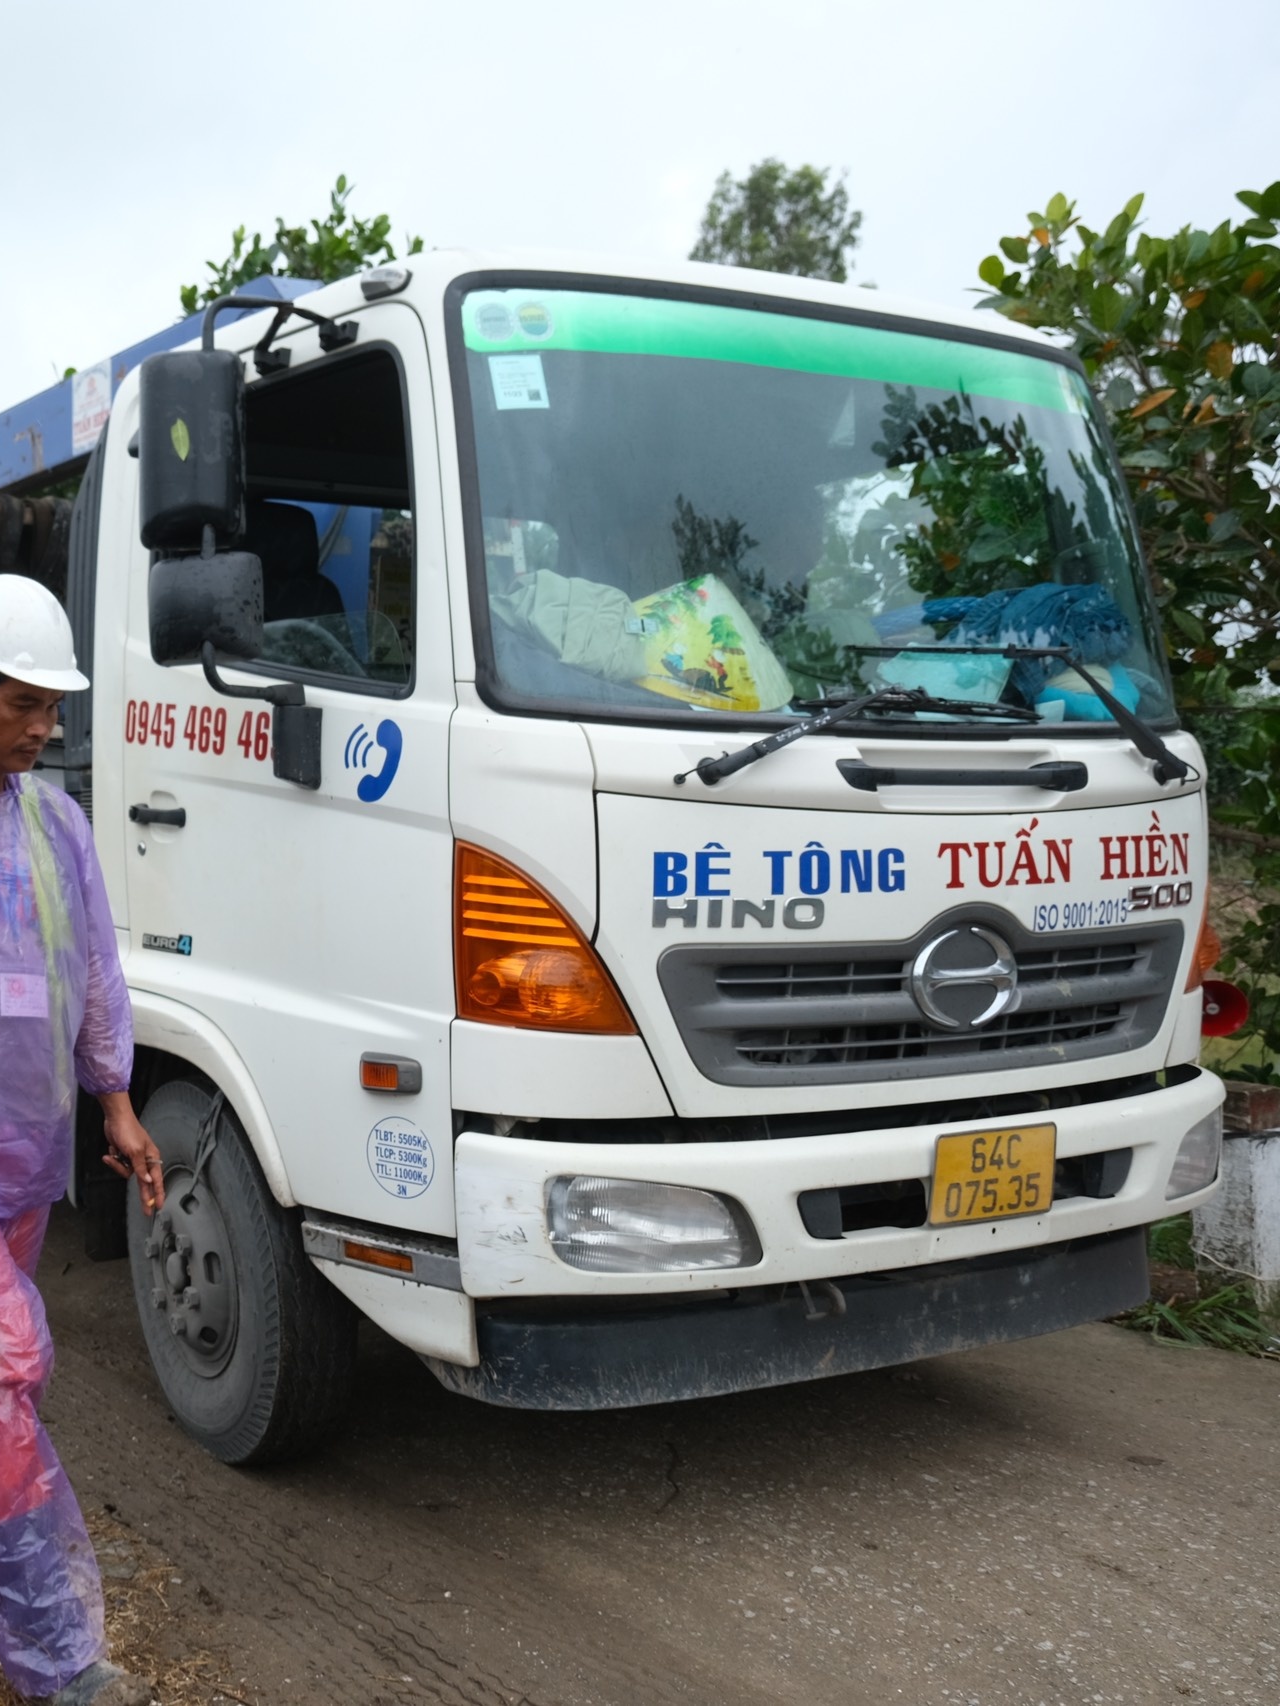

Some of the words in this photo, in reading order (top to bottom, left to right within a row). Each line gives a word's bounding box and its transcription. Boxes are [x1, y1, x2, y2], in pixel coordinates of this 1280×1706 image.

[125, 700, 177, 748] 0945
[183, 705, 227, 756] 469
[237, 710, 275, 761] 46
[653, 842, 731, 897] BÊ
[763, 841, 906, 895] TÔNG
[937, 817, 1073, 888] TUẤN
[1099, 810, 1190, 880] HIỀN
[1128, 881, 1193, 912] 500
[652, 897, 826, 930] HINO
[1033, 903, 1059, 932] ISO
[1063, 898, 1128, 929] 9001:2015
[375, 1129, 396, 1143] TLBT:
[398, 1133, 427, 1151] 5505Kg
[971, 1134, 1022, 1173] 64C
[375, 1146, 396, 1160] TLCP:
[398, 1150, 427, 1168] 5300Kg
[376, 1163, 392, 1176] TTL:
[394, 1167, 427, 1185] 11000Kg
[397, 1184, 407, 1196] 3N
[944, 1172, 1041, 1217] 075.35
